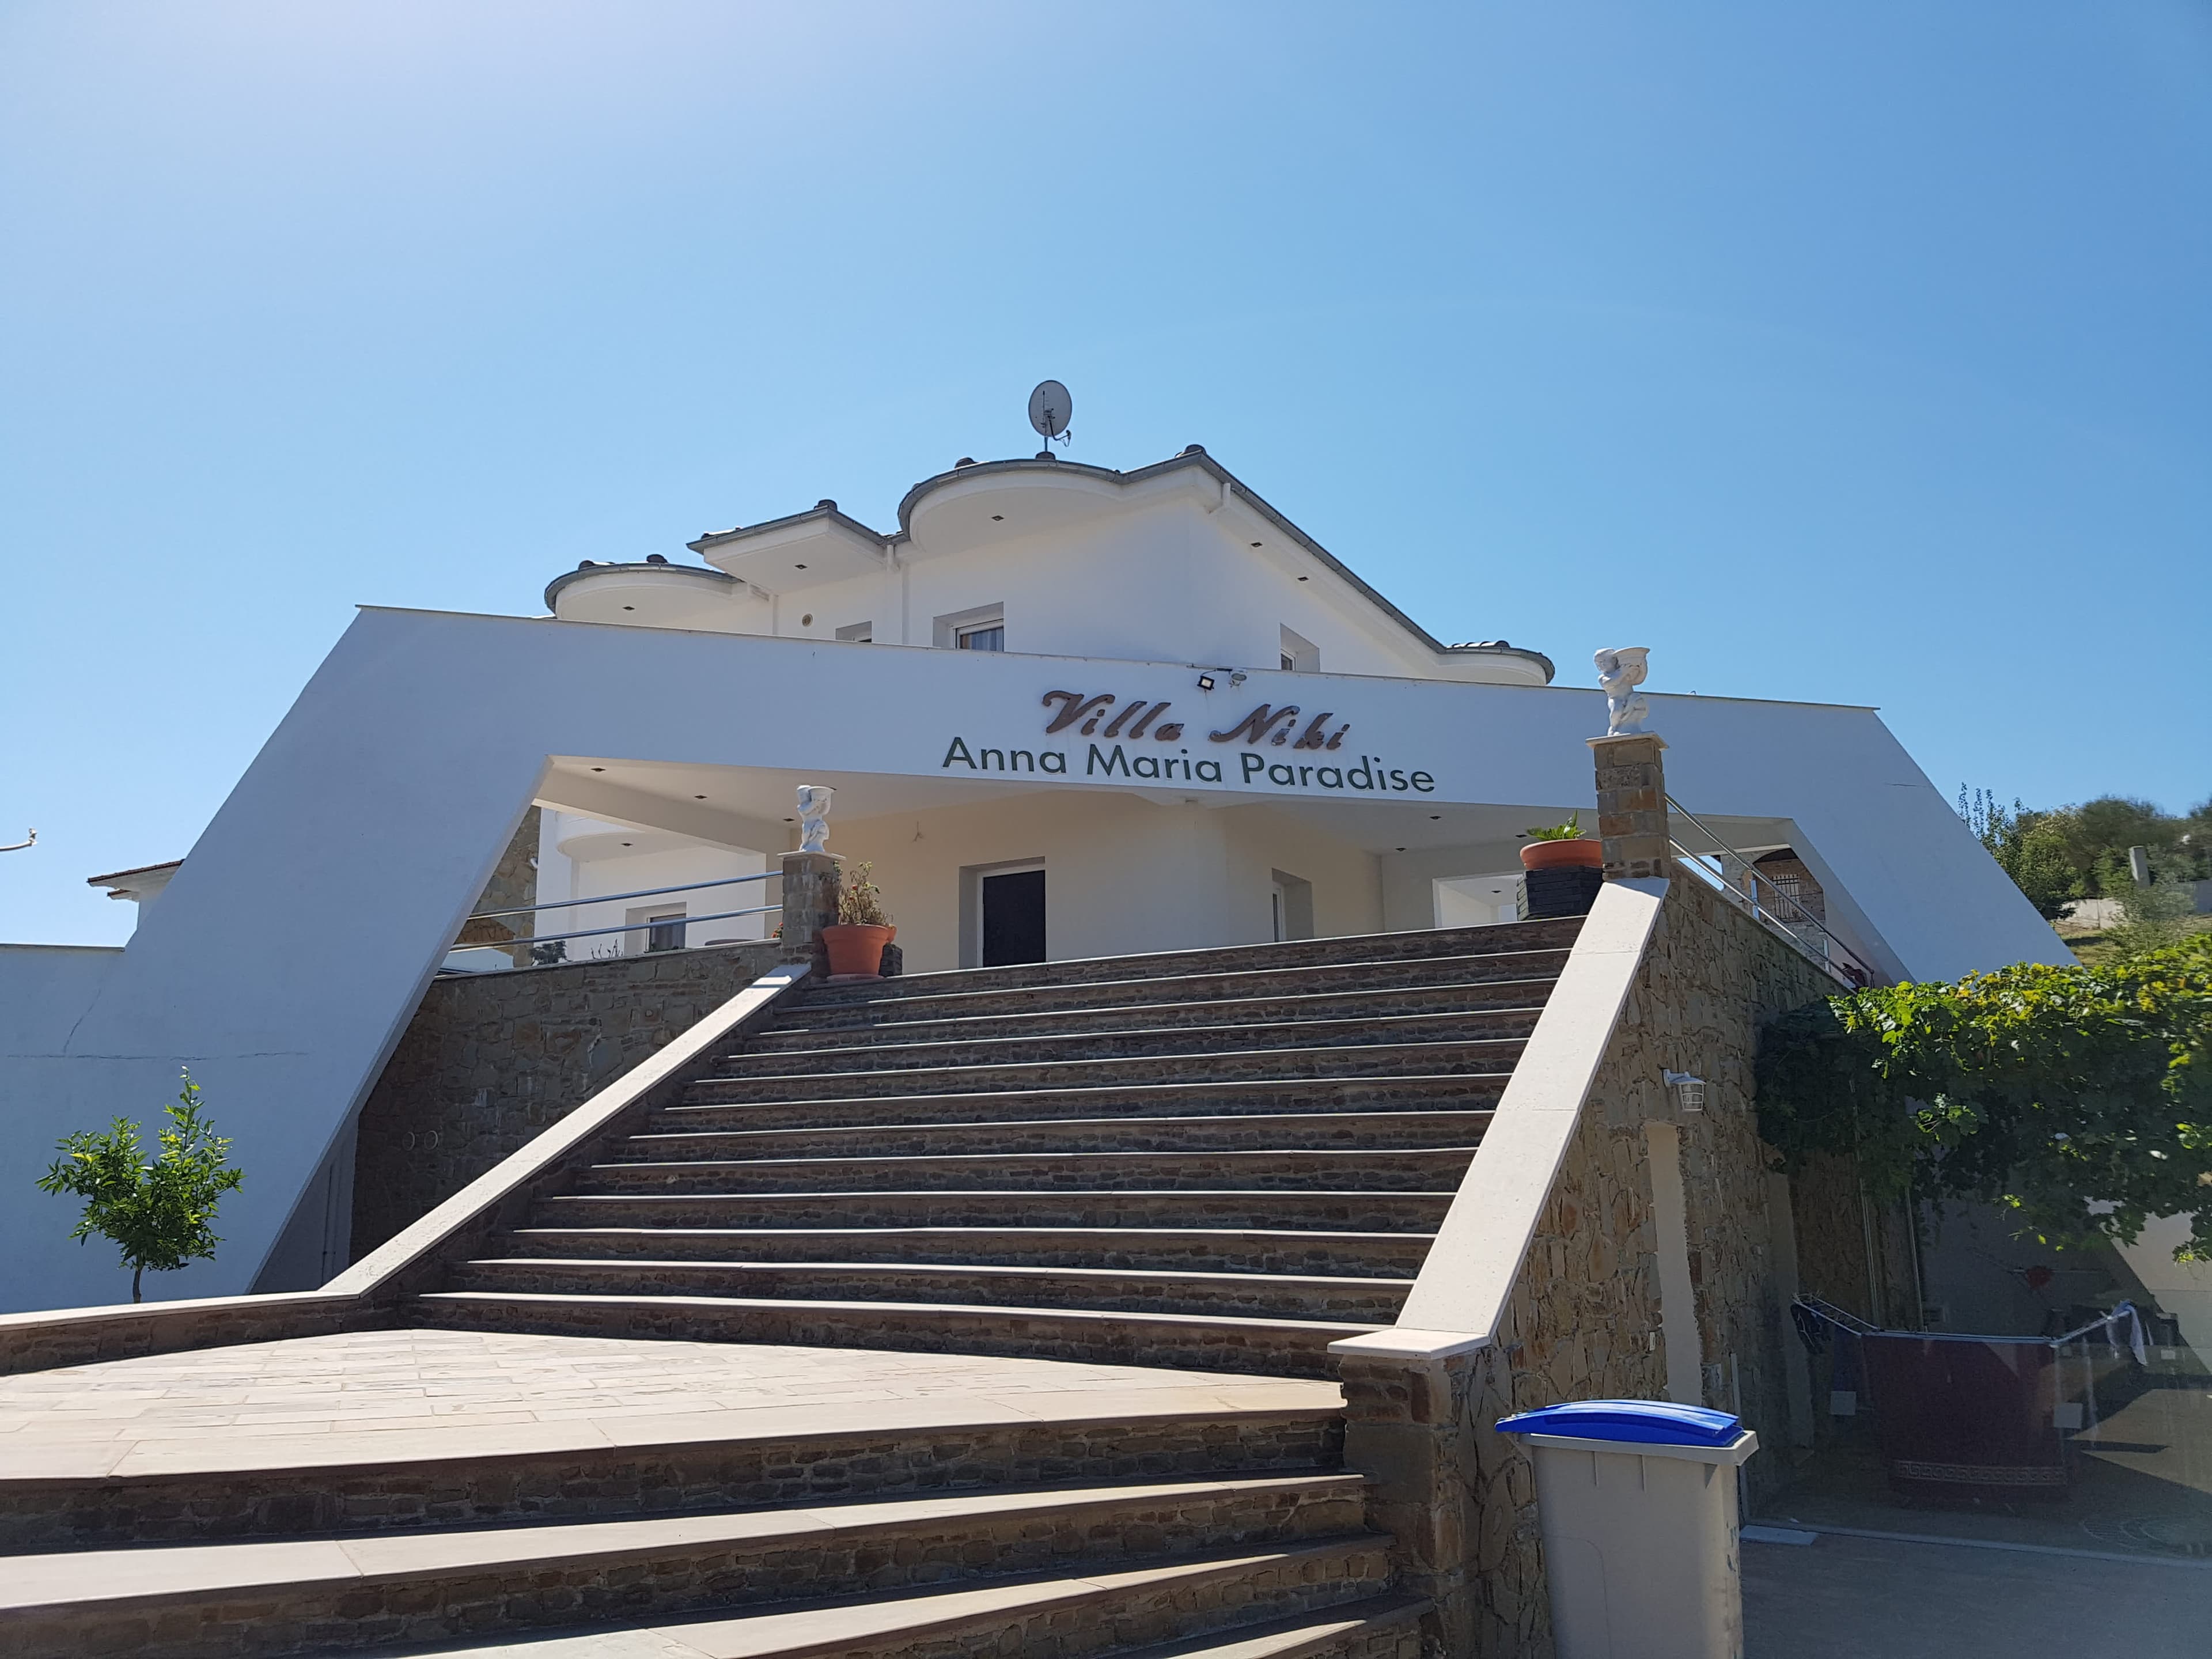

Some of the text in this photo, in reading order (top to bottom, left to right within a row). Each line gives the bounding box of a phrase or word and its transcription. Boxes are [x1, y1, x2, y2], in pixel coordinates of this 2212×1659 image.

[1041, 690, 1351, 750] Villa Niki
[942, 737, 1435, 793] Anna Maria Paradise
